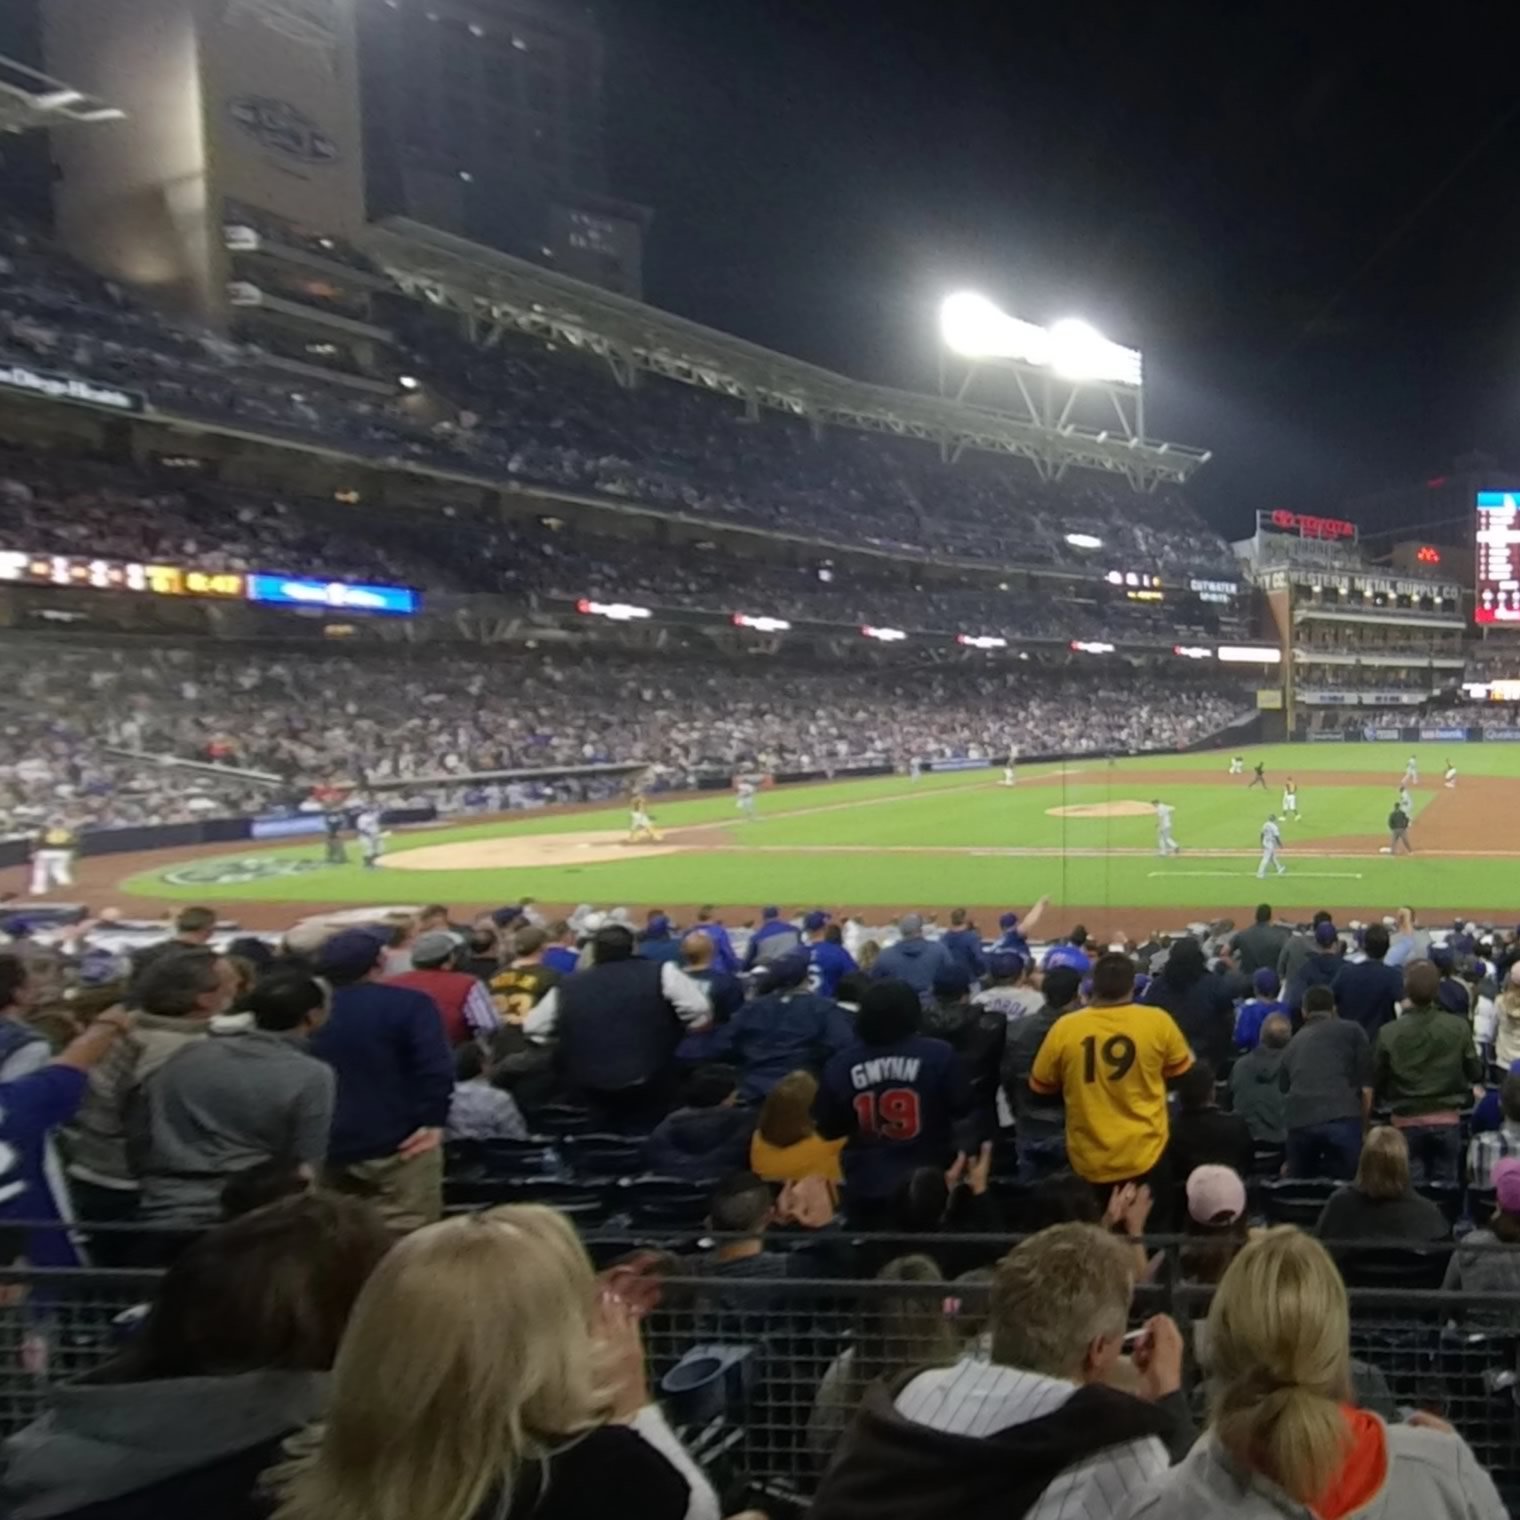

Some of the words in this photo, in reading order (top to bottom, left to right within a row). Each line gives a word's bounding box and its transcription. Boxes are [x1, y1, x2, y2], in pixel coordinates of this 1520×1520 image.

[1289, 570, 1349, 590] WESTERN
[1354, 576, 1392, 593] METAL
[1396, 583, 1440, 599] SUPPLY
[851, 1056, 920, 1090] GWYNN
[1081, 1033, 1137, 1083] 19
[852, 1087, 921, 1141] 19
